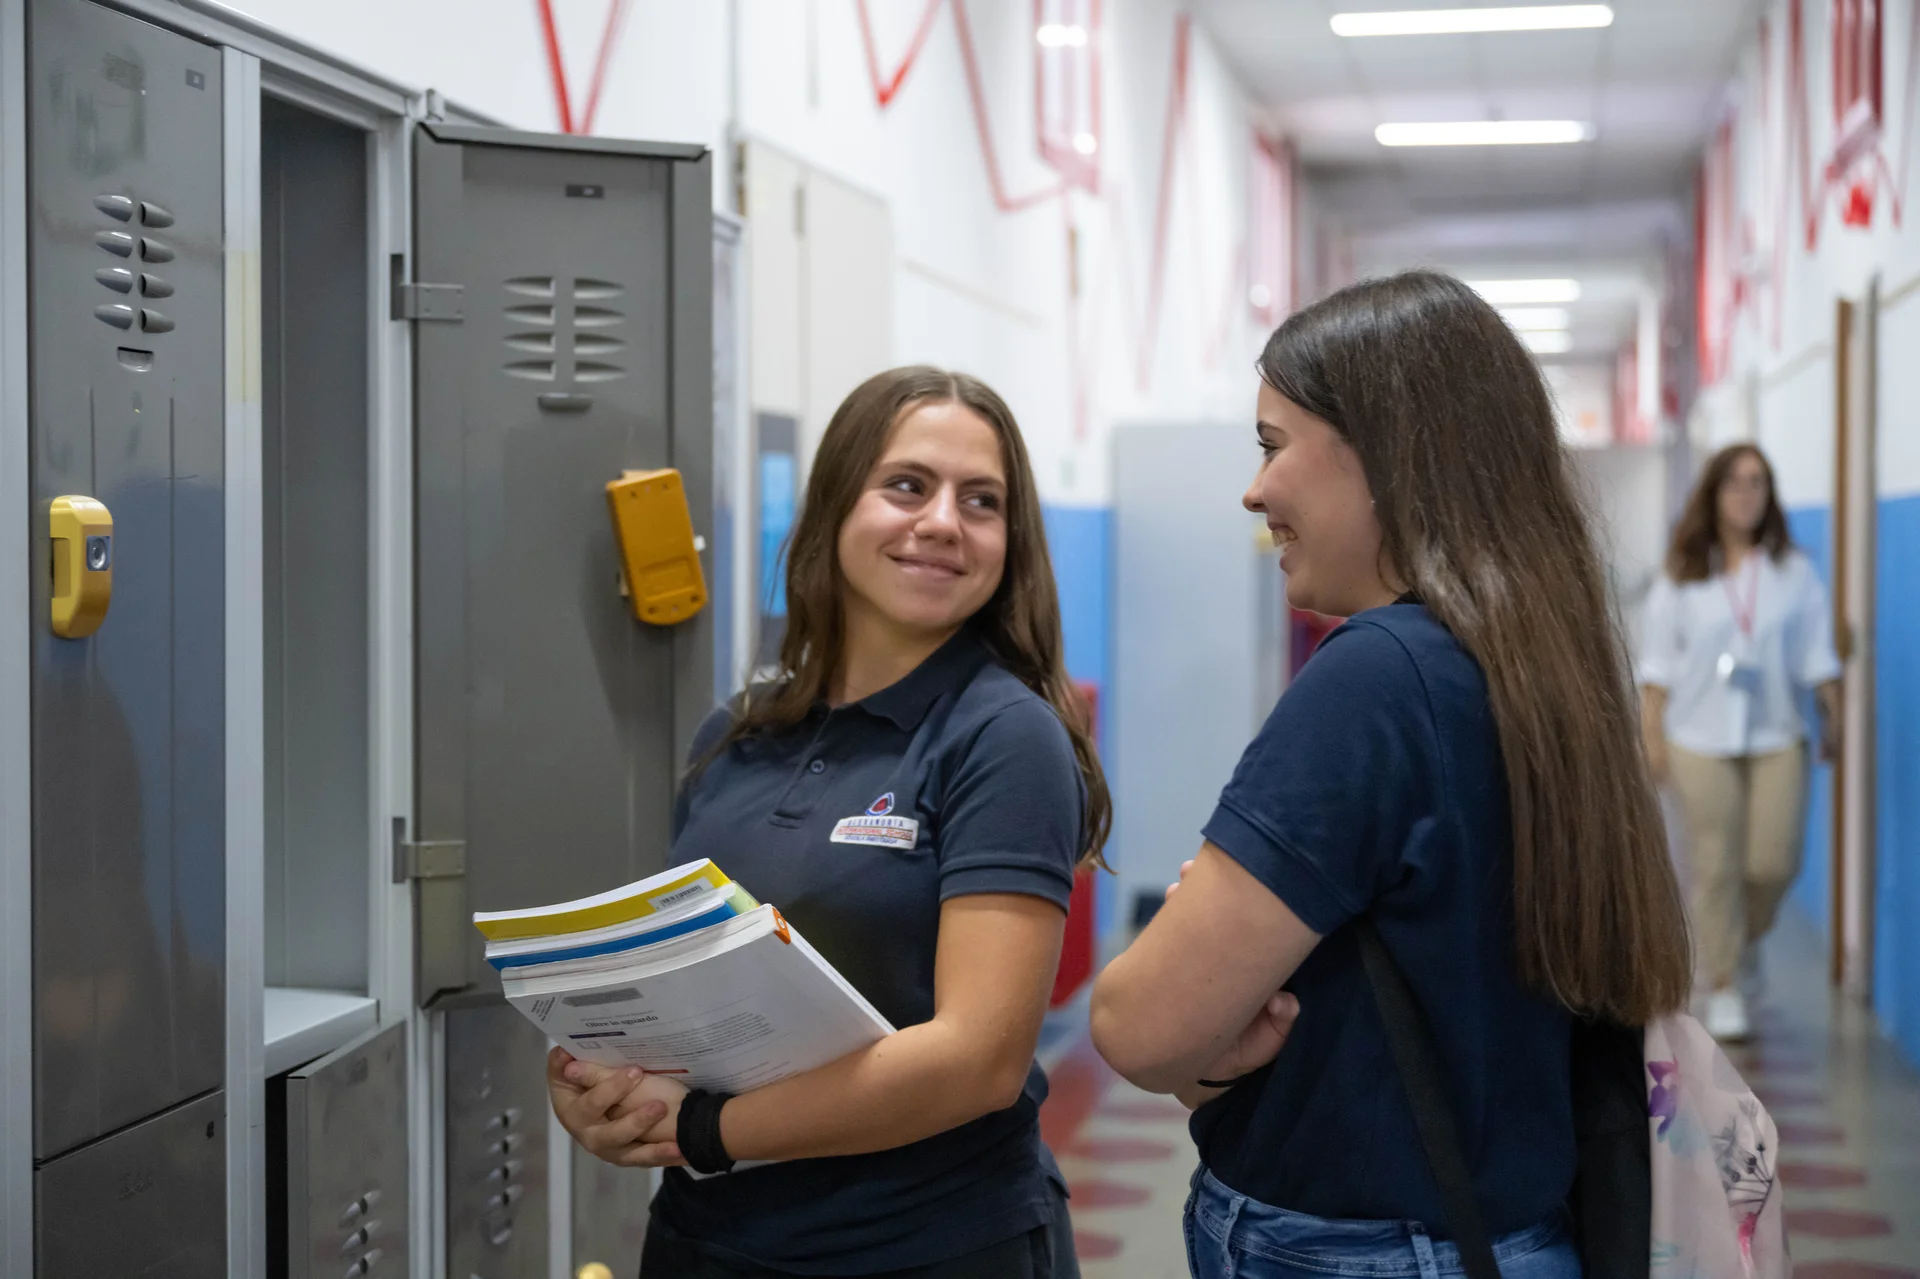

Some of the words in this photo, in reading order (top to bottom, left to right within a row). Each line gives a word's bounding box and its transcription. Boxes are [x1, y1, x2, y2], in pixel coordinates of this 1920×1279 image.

[585, 1020, 609, 1028] Oltre
[610, 1018, 620, 1026] lo
[621, 1015, 658, 1026] sguardo
